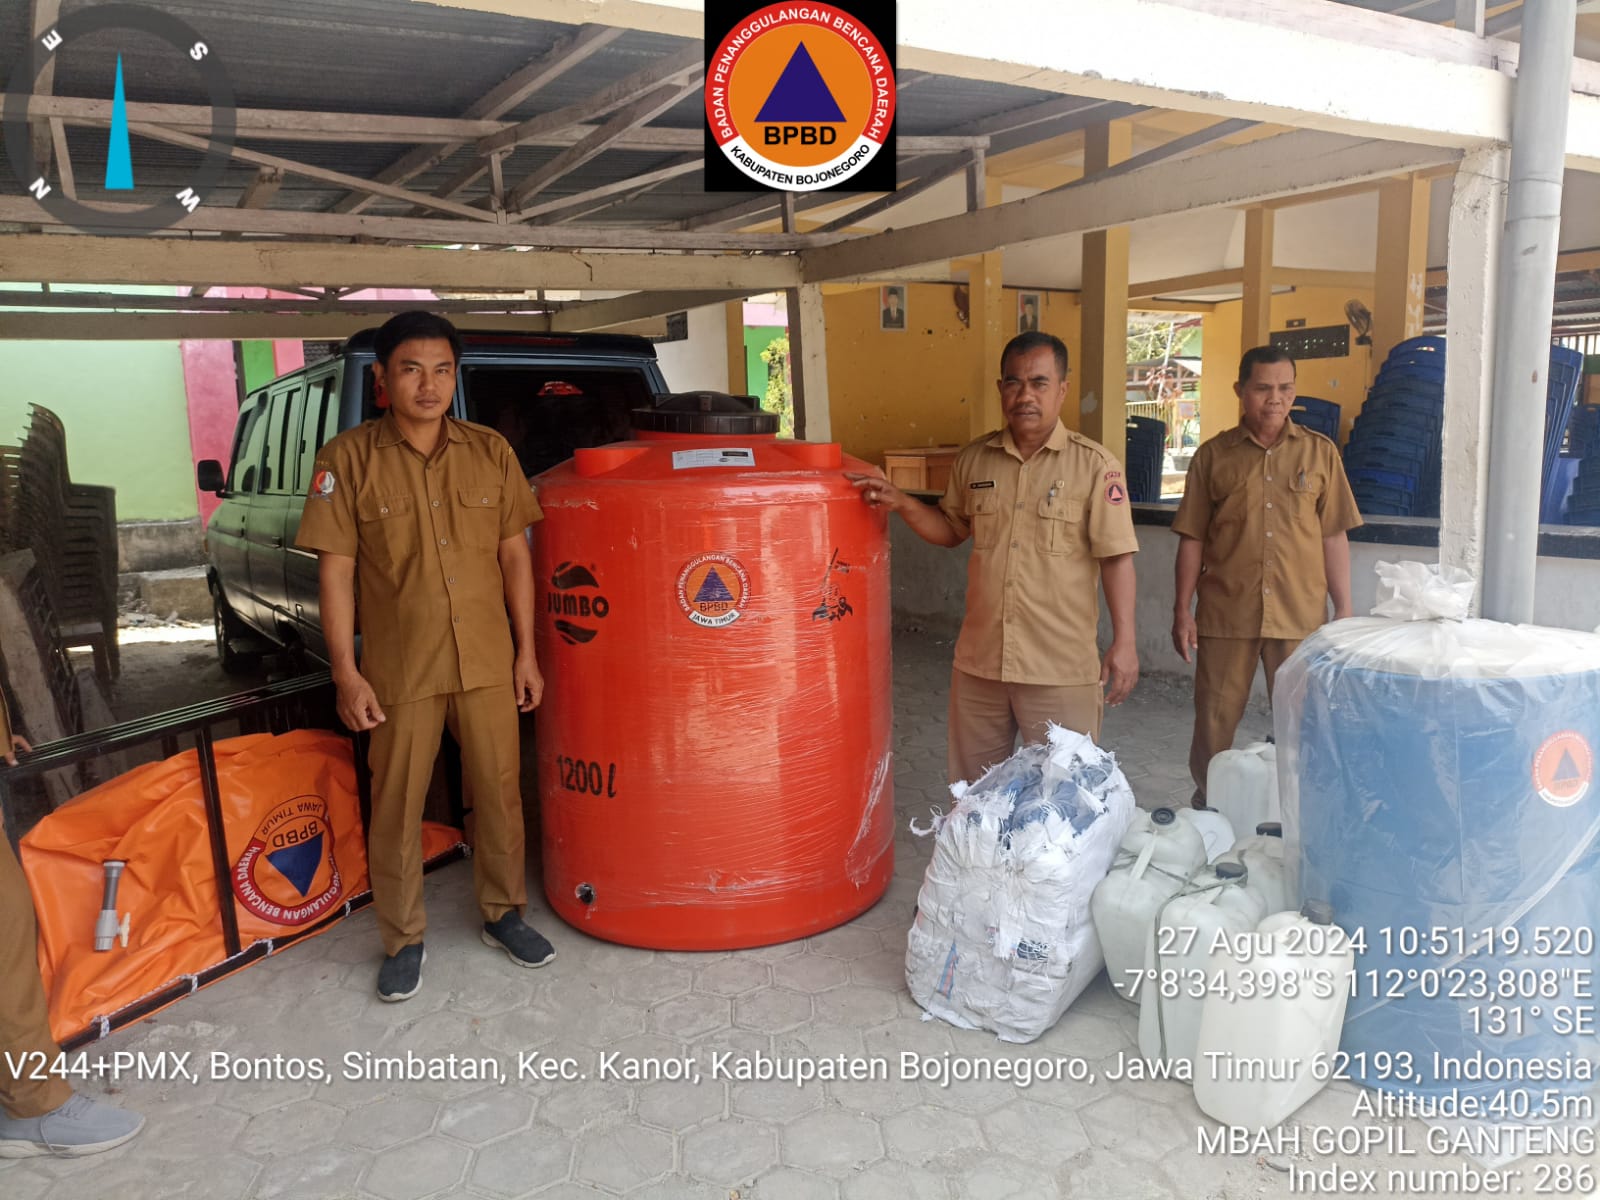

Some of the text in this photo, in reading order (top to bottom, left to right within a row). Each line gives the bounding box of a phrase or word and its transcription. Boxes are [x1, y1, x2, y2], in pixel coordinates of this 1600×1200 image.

[547, 591, 609, 618] JUMBO
[692, 612, 735, 625] JAWA TIMUR
[556, 755, 602, 796] 1200
[261, 802, 323, 836] JAWA TIMUR
[272, 820, 318, 848] BPBD
[236, 846, 261, 881] DAERAH
[239, 881, 281, 917] BENCANA
